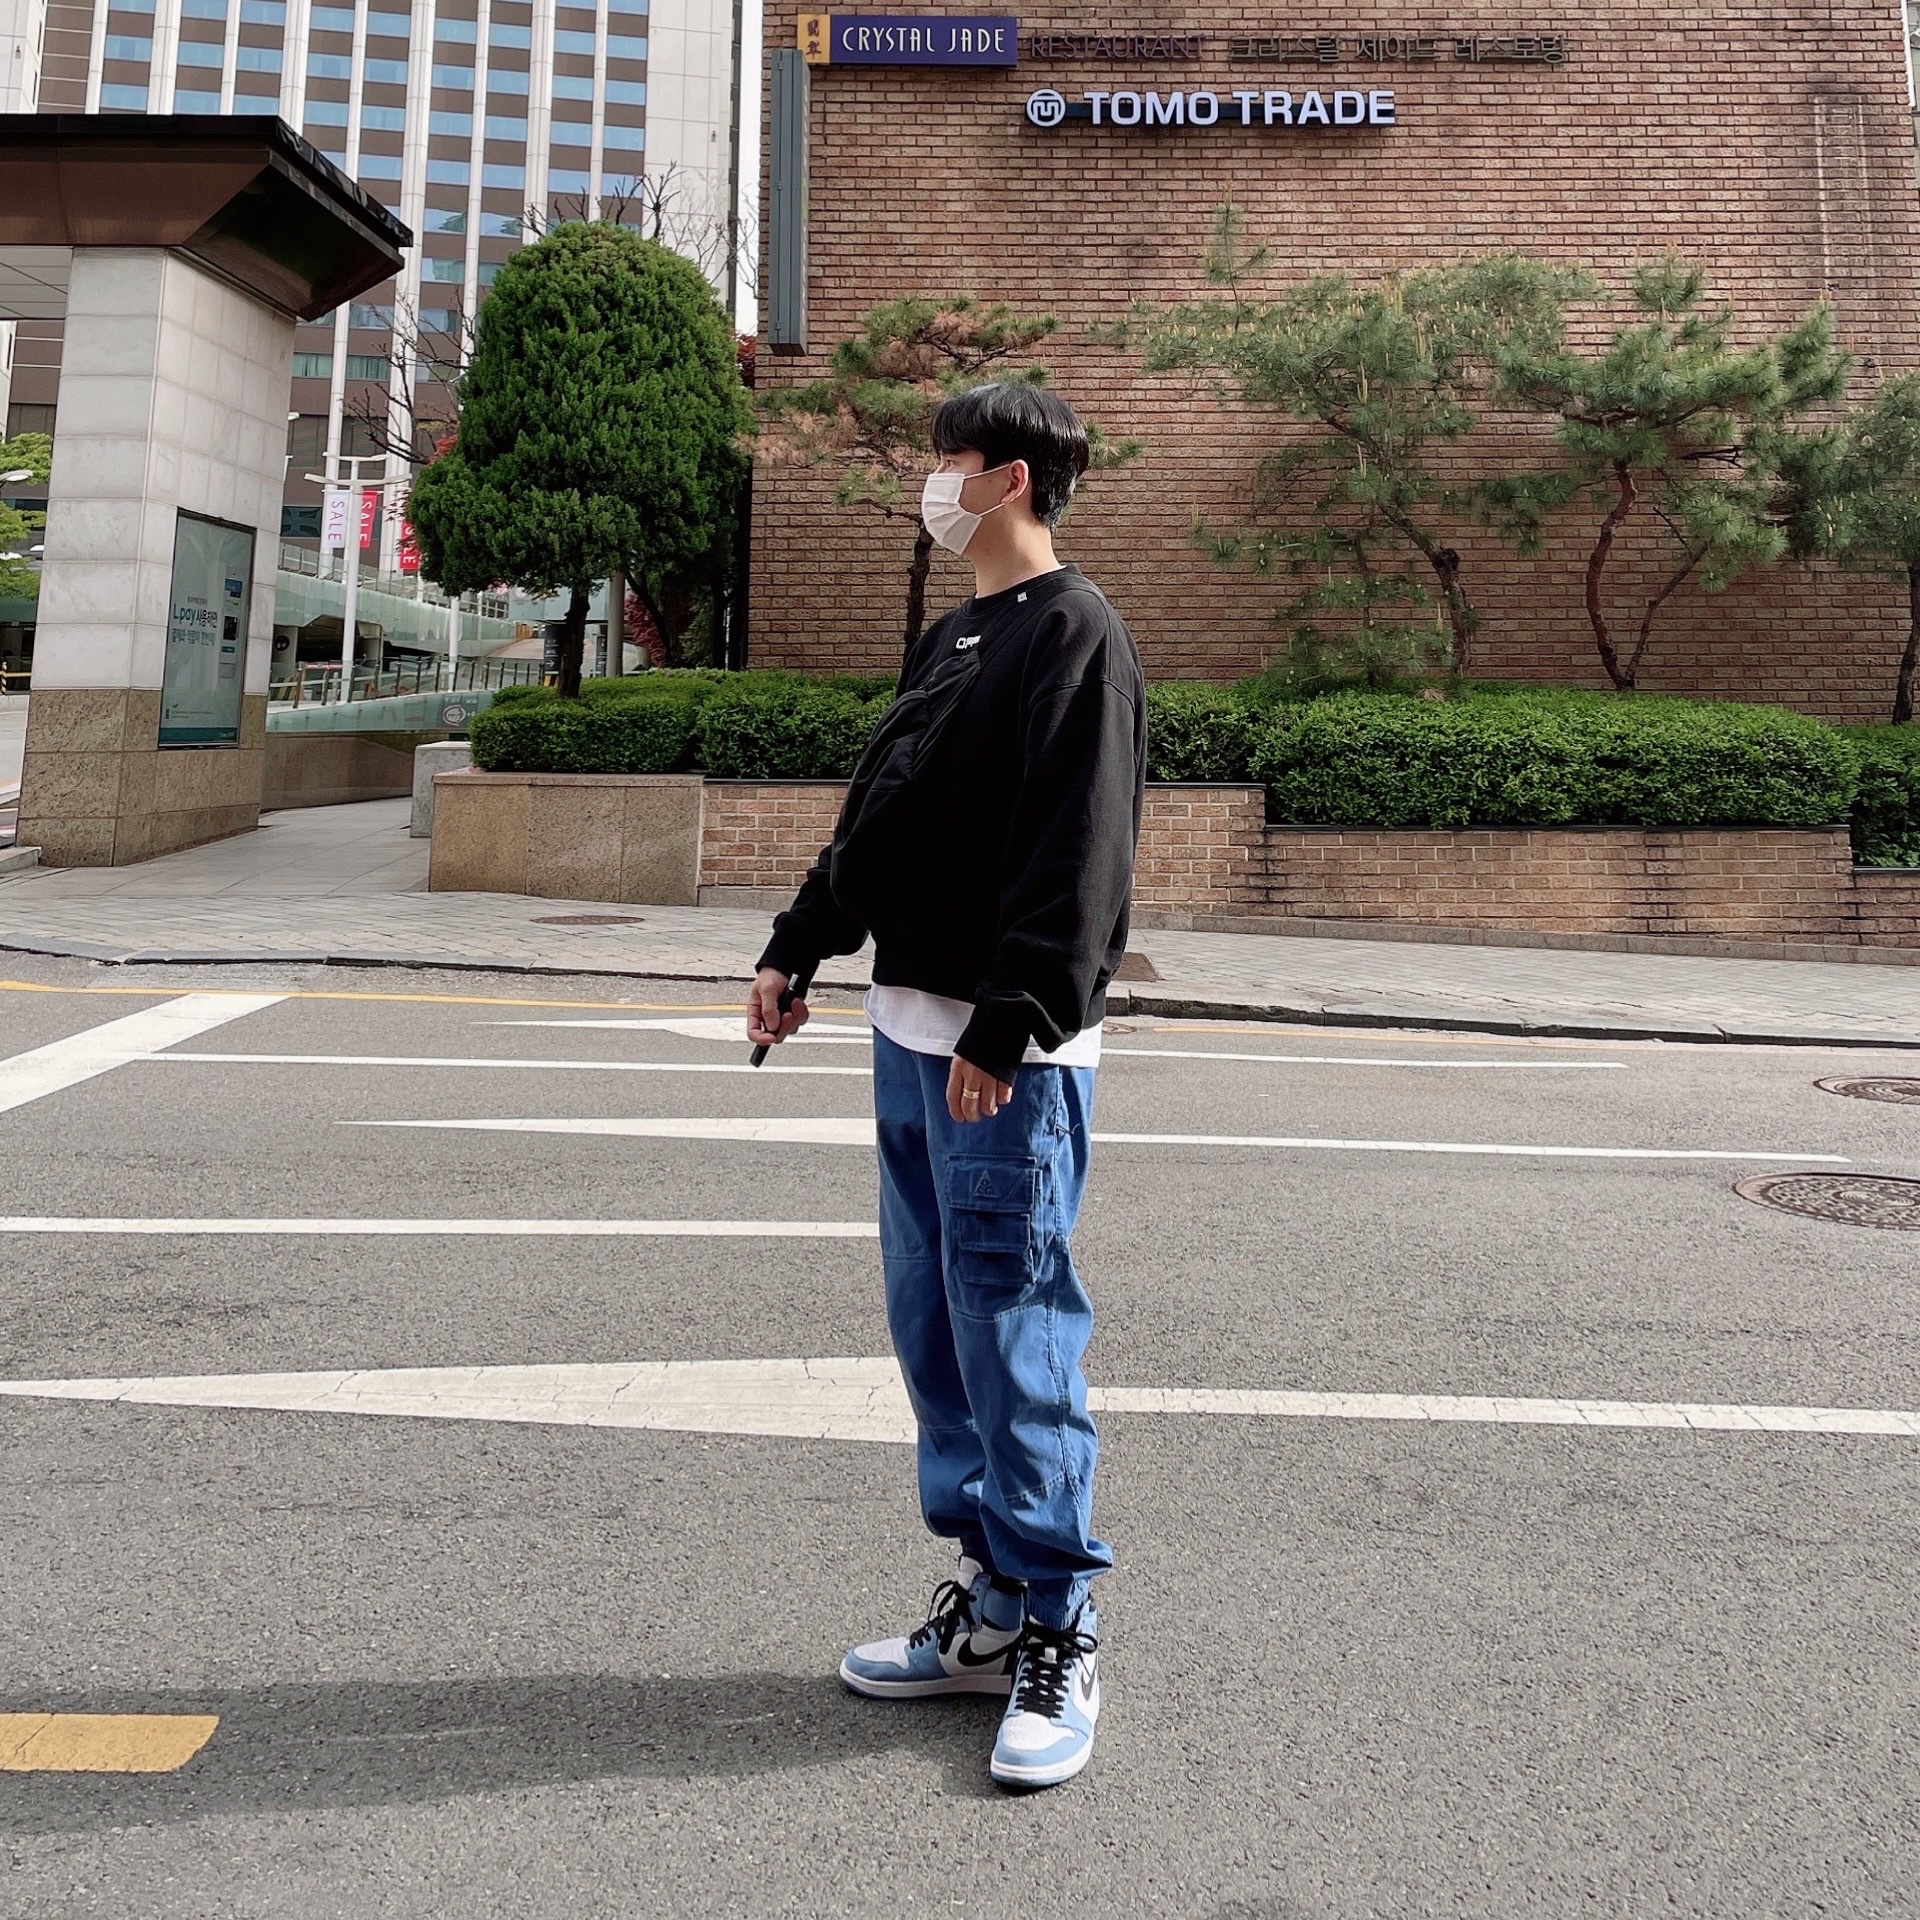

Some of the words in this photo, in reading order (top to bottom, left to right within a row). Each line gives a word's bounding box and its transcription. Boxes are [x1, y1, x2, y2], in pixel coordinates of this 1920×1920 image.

[842, 26, 935, 52] CRYSTAL
[947, 28, 1005, 53] JADE
[1031, 33, 1206, 59] RESTAURANT
[1228, 36, 1343, 62] 크리스탈
[1356, 36, 1441, 62] 제이드
[1455, 34, 1569, 63] 레스토랑
[1084, 91, 1219, 125] TOMO
[1232, 90, 1396, 125] TRADE
[328, 501, 345, 542] SALE
